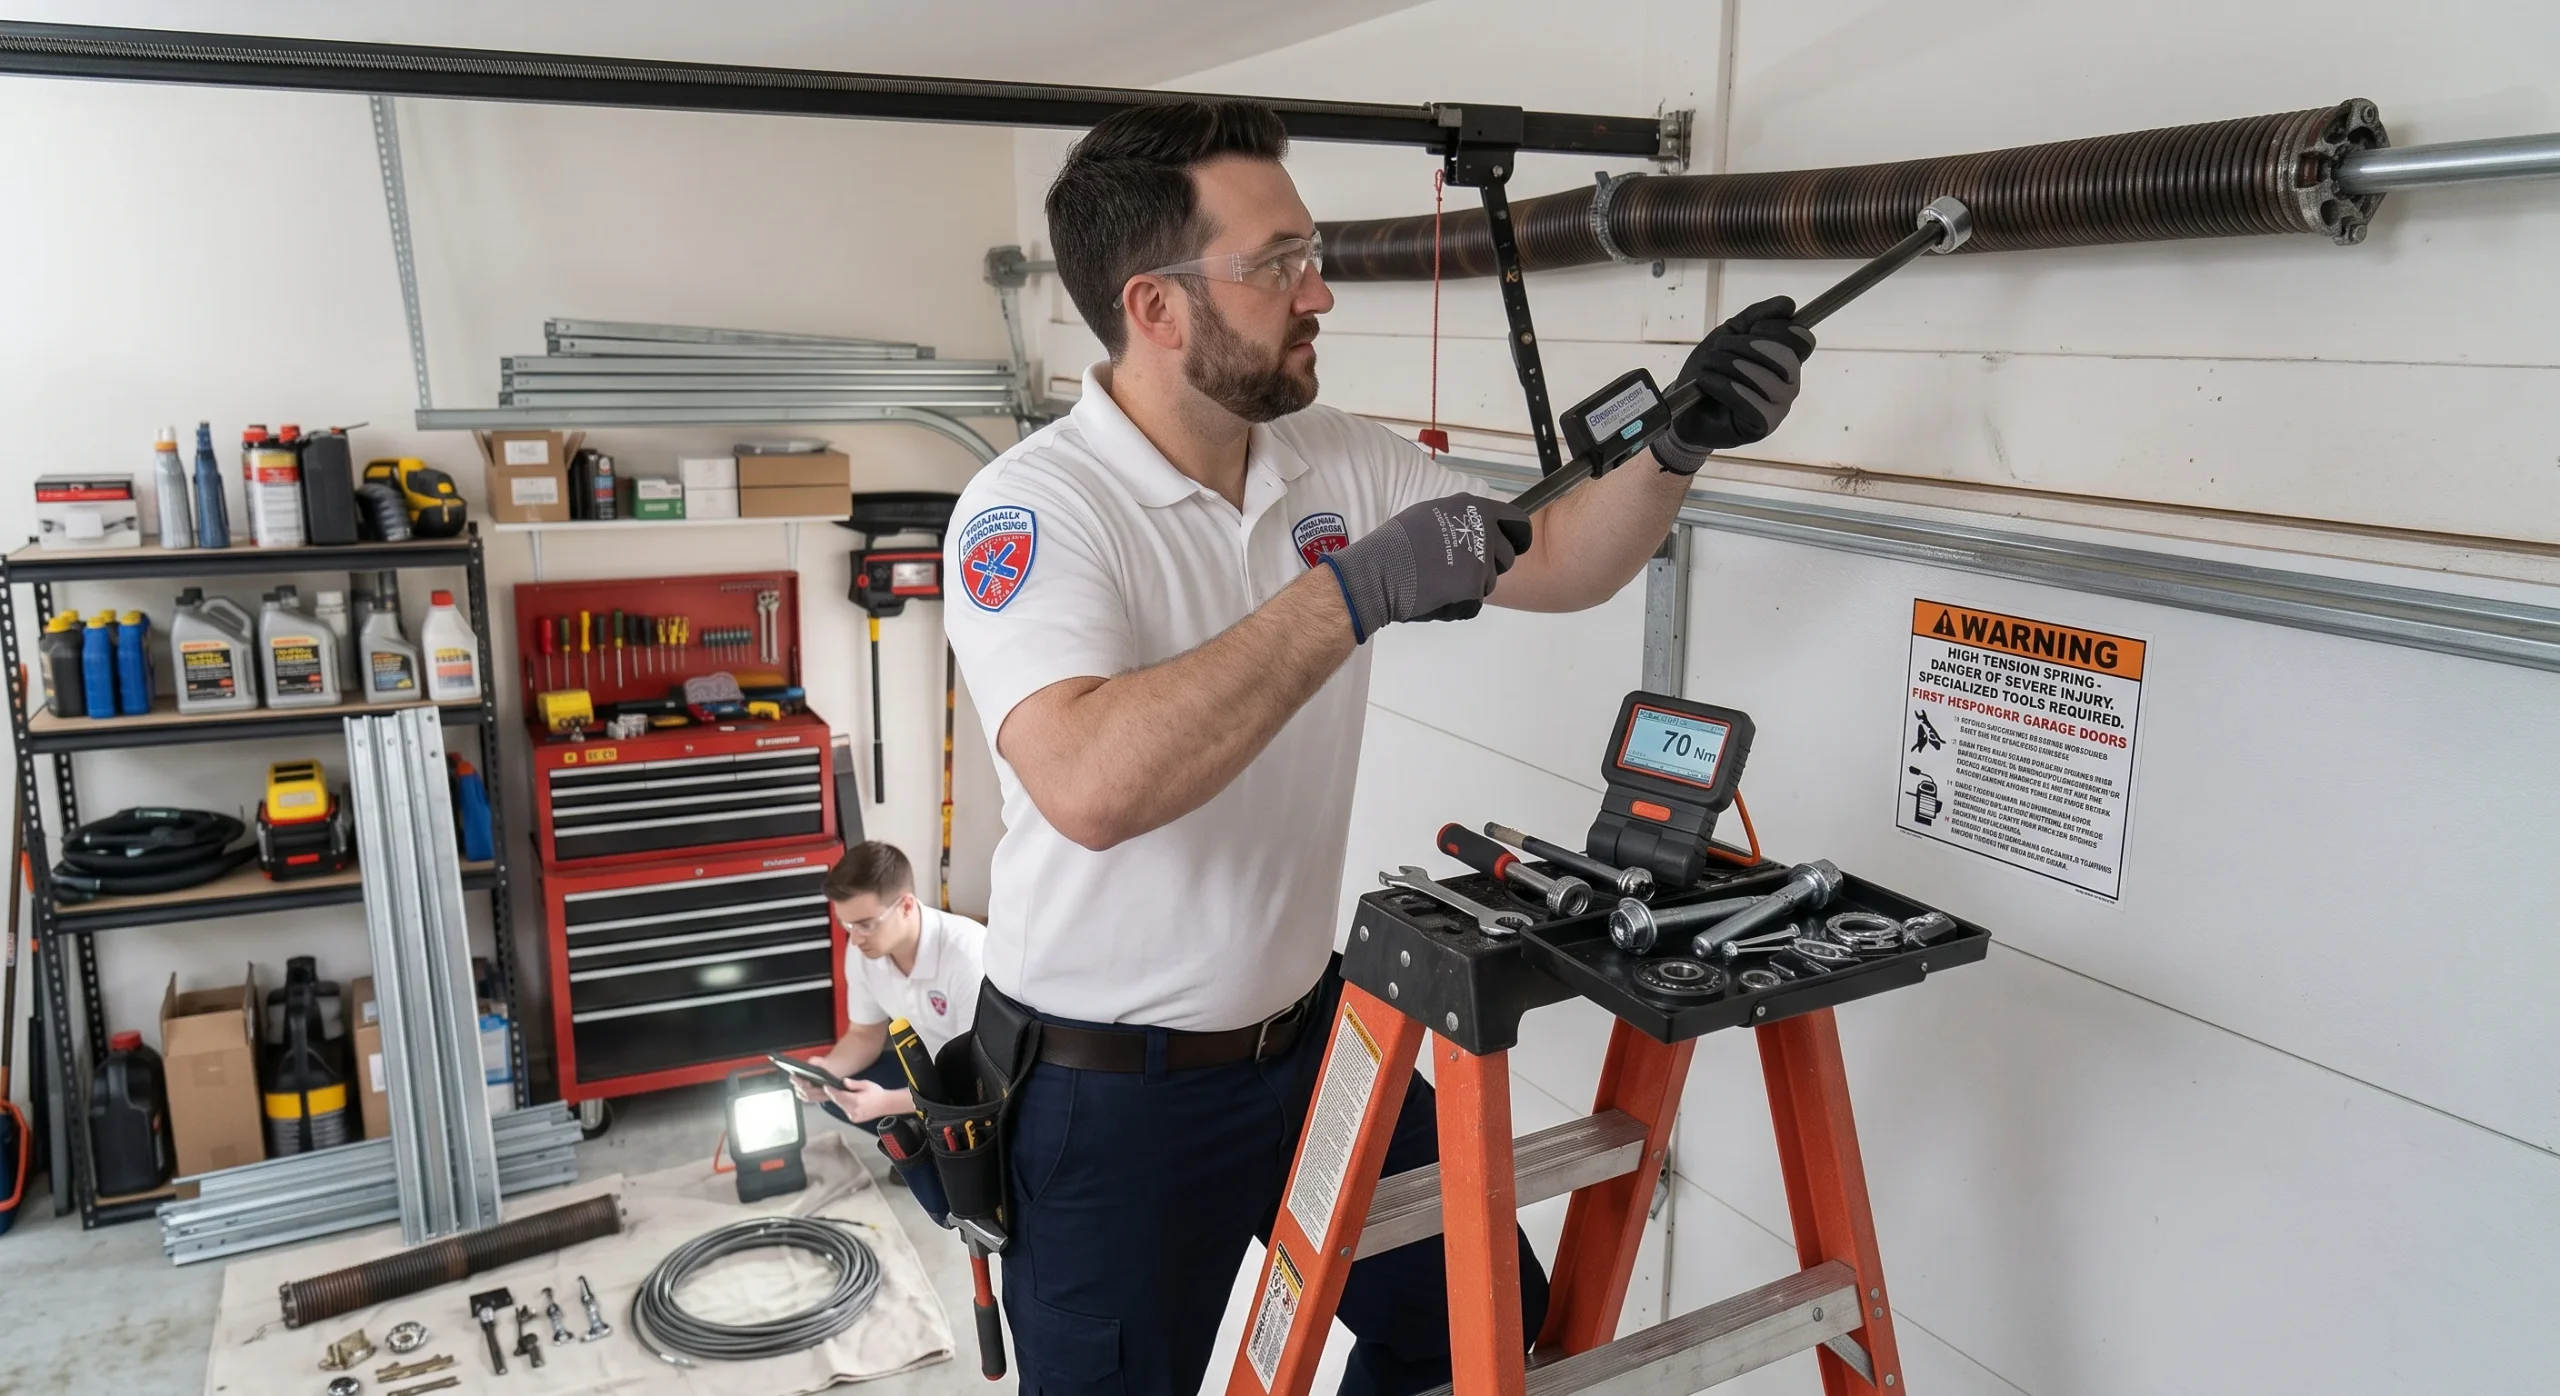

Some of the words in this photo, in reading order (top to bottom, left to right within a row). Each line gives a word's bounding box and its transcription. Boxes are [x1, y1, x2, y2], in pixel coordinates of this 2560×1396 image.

[1947, 646, 1980, 664] HIGH
[1982, 654, 2040, 677] TENSION
[1960, 613, 2119, 670] WARNING
[1918, 670, 1999, 699] SPECIALIZED
[2002, 689, 2046, 710] TOOLS
[2048, 700, 2125, 729] REQUIRED.
[1930, 658, 1982, 681] DANGER
[1984, 670, 2002, 684] OF
[2004, 675, 2058, 697] SEVERE
[2060, 686, 2114, 711] INJURY.
[1912, 687, 1945, 705] FIRST
[2023, 714, 2077, 737] GARAGE
[2079, 727, 2127, 749] DOORS
[1662, 730, 1692, 757] 70
[1693, 747, 1716, 763] Nm
